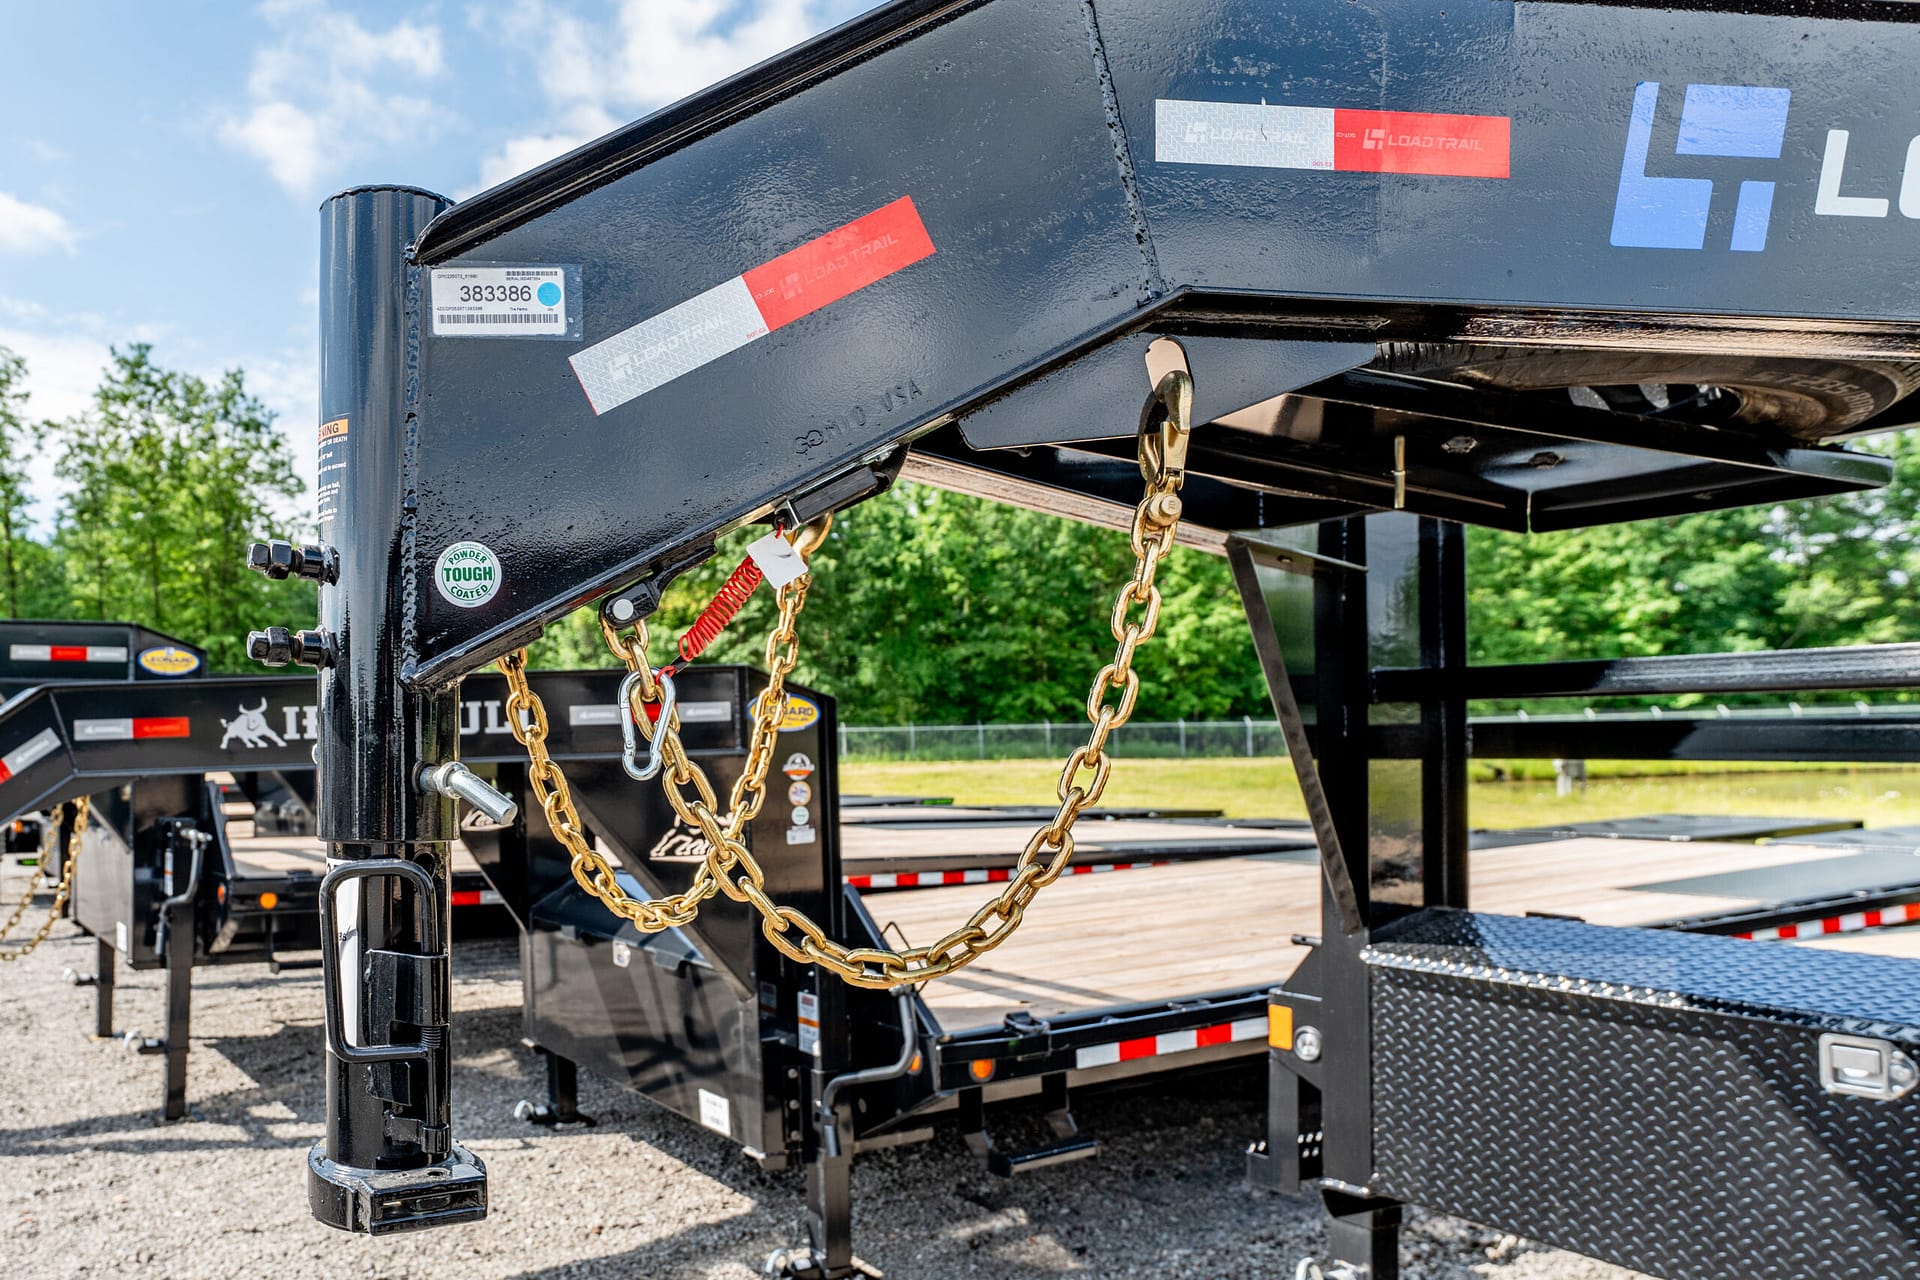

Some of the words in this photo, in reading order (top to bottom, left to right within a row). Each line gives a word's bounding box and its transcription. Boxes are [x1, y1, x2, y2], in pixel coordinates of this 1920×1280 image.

[1387, 134, 1433, 148] LOAD
[1438, 137, 1484, 151] TRAIL
[1814, 129, 1920, 219] L
[803, 255, 849, 285] LOAD
[850, 233, 899, 264] TRAIL
[459, 285, 532, 302] 383386
[448, 550, 487, 565] POWDER
[443, 566, 493, 582] TOUGH
[450, 584, 488, 598] COATED
